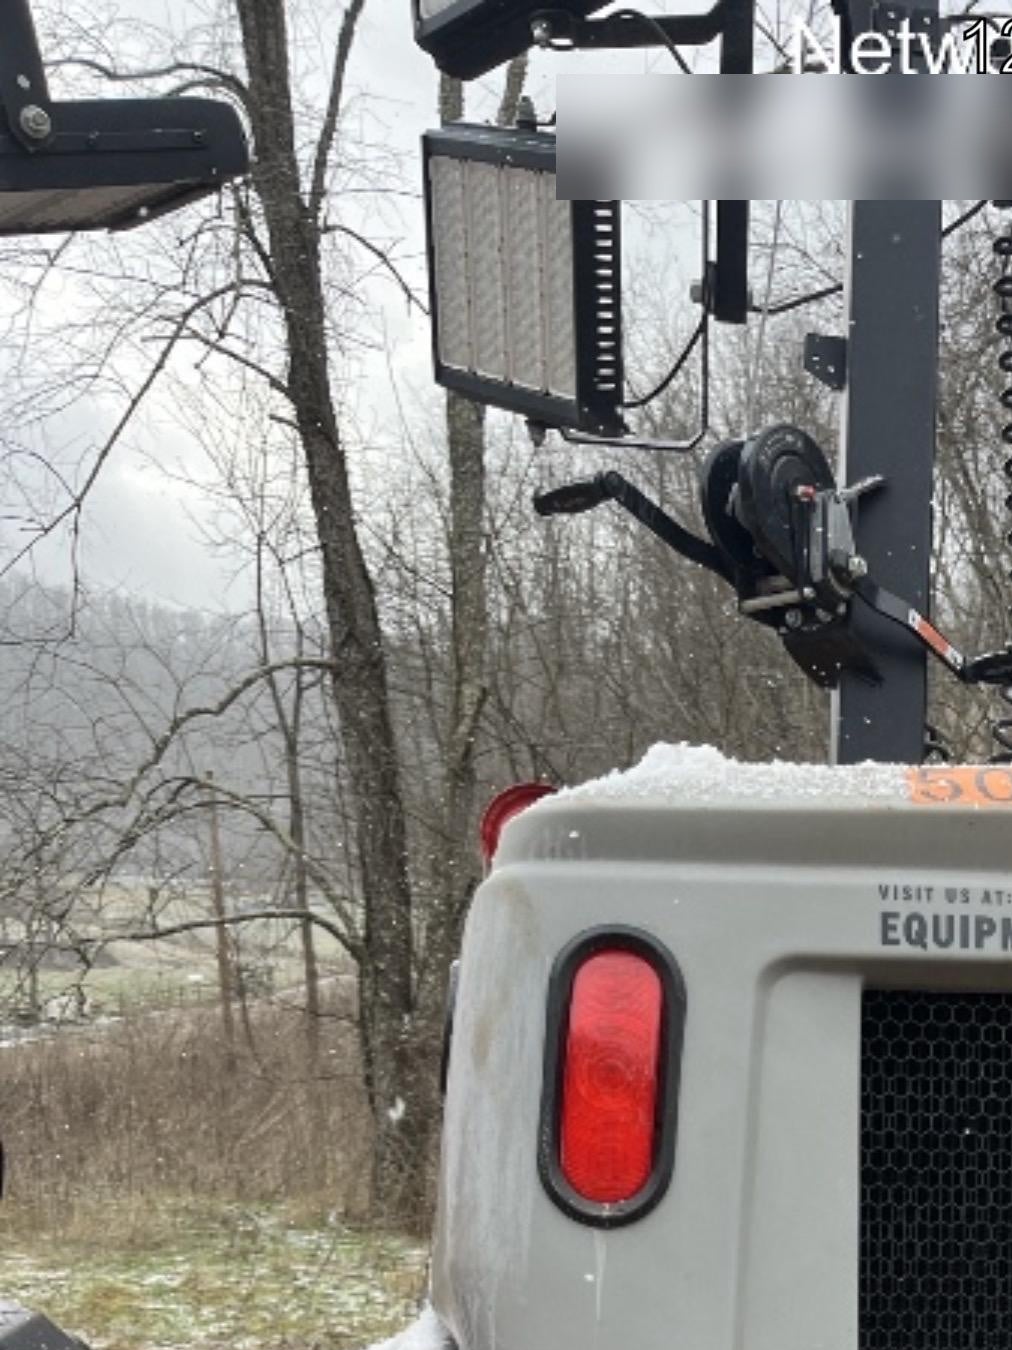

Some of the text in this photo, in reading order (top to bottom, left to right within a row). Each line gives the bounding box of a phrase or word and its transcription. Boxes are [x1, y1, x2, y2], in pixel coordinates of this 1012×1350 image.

[878, 884, 1012, 906] VISIT US AT:
